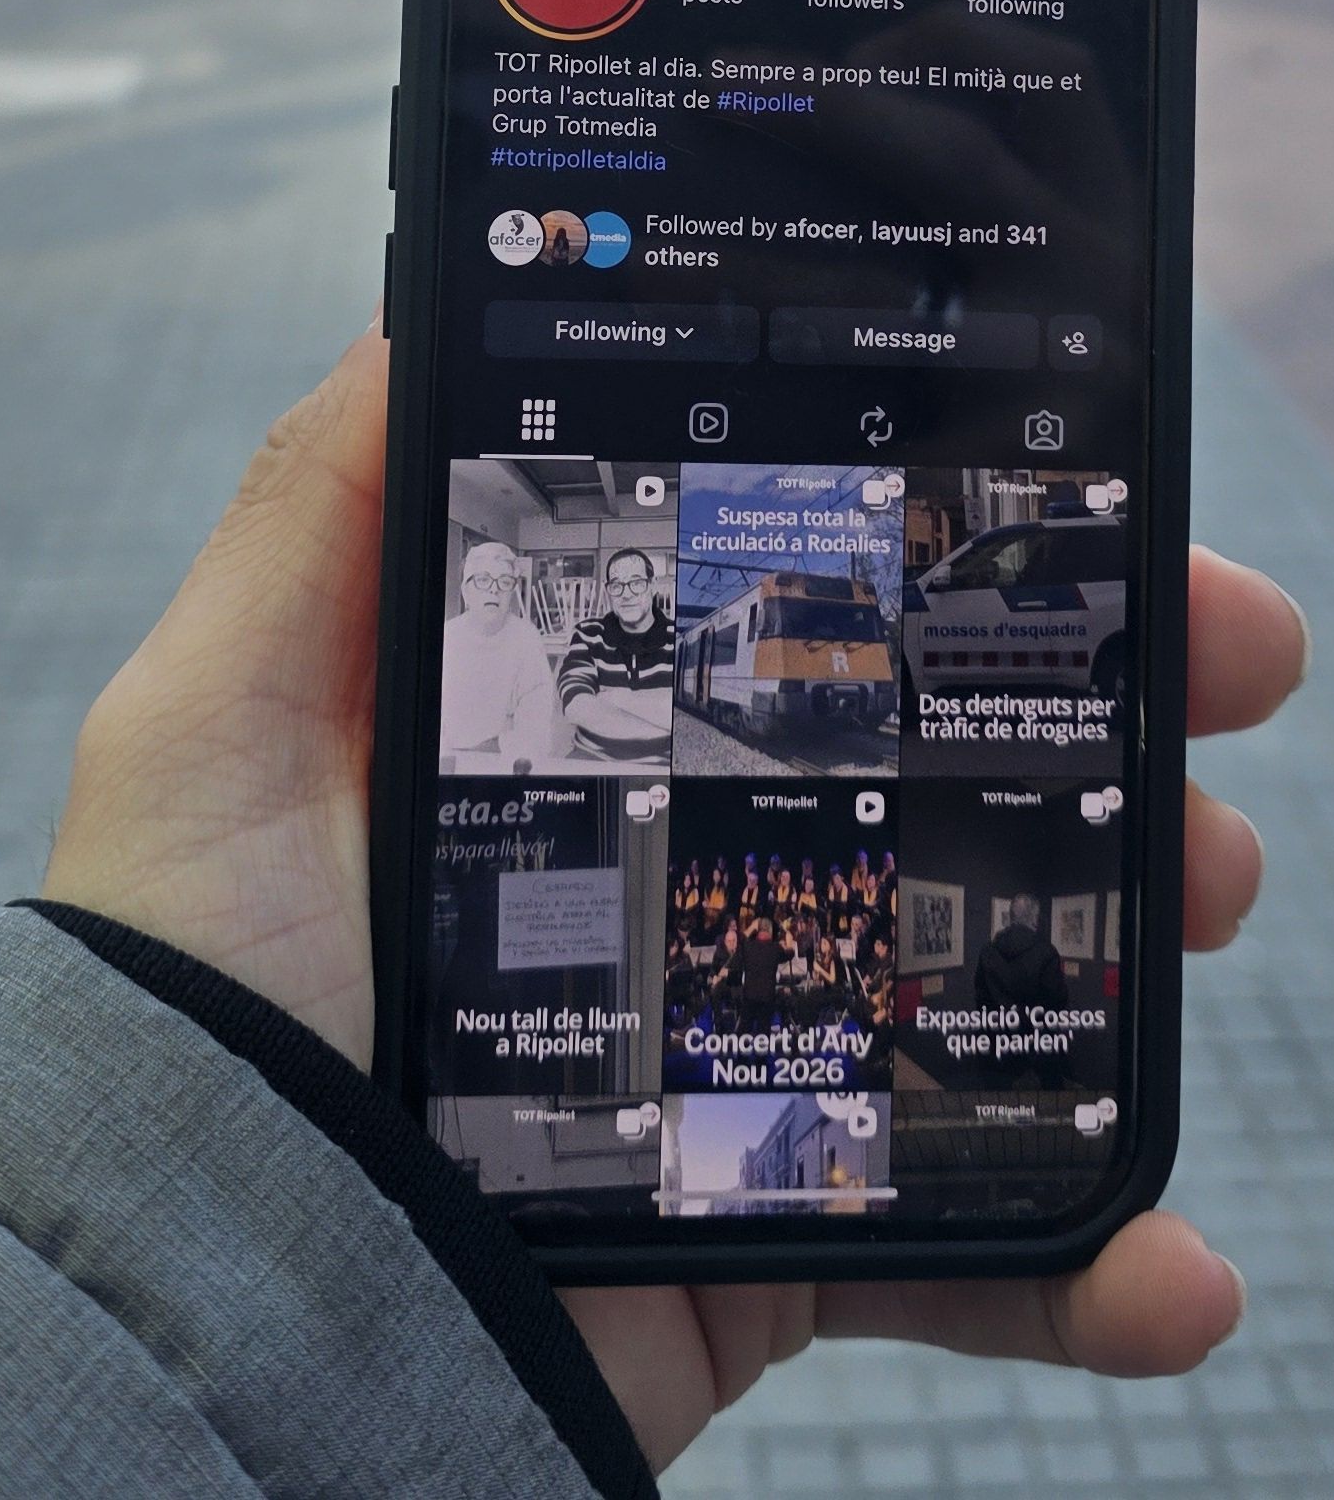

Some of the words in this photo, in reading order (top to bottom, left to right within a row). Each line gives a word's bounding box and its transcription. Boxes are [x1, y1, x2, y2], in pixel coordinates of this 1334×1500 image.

[495, 53, 541, 72] TOT
[549, 54, 631, 77] Ripollet
[639, 57, 656, 76] al
[664, 58, 702, 77] dia.
[711, 60, 795, 84] Sempre
[803, 67, 814, 81] a
[823, 68, 871, 87] prop
[879, 66, 919, 84] teu!
[929, 67, 946, 86] El
[955, 68, 1005, 91] mitjà
[1013, 75, 1053, 92] que
[1061, 73, 1081, 91] et
[494, 86, 554, 107] porta
[560, 85, 675, 108] l'actualitat
[683, 90, 710, 109] de
[717, 92, 814, 114] #Ripollet
[493, 114, 546, 137] Grup
[555, 116, 656, 137] Totmedia
[491, 148, 665, 171] #totripolletaldia
[489, 232, 542, 246] afocer
[647, 215, 743, 235] Followed
[752, 217, 777, 241] by
[785, 218, 862, 243] afocer,
[873, 221, 951, 246] layuusj
[959, 224, 998, 243] and
[1007, 225, 1046, 245] 341
[645, 246, 718, 266] others
[556, 320, 665, 346] Following
[855, 328, 955, 353] Message
[776, 477, 798, 488] TOT
[798, 478, 836, 491] Ripollet
[987, 482, 1009, 494] TOT
[1009, 483, 1047, 495] Ripollet
[717, 507, 798, 530] Suspesa
[802, 510, 844, 527] tota
[848, 508, 867, 528] la
[691, 532, 787, 552] circulació
[790, 538, 803, 552] a
[808, 534, 891, 554] Rodalies
[924, 623, 988, 638] mossos
[994, 621, 1087, 640] d'esquadra
[919, 693, 961, 715] Dos
[966, 693, 1073, 720] detinguts
[1077, 698, 1117, 721] per
[920, 717, 980, 740] tràfic
[984, 717, 1013, 740] de
[1017, 717, 1108, 746] drogues
[523, 791, 546, 802] TOT
[547, 790, 586, 804] Ripollet
[751, 796, 777, 808] TOT
[777, 796, 818, 810] Ripollet
[982, 792, 1005, 804] TOT
[1005, 792, 1042, 805] Ripollet
[455, 1008, 506, 1034] Nou
[510, 1008, 549, 1034] tall
[553, 1008, 582, 1032] de
[587, 1007, 641, 1032] llum
[915, 1005, 1020, 1035] Exposició
[1025, 1006, 1106, 1031] 'Cossos
[495, 1036, 511, 1057] a
[515, 1031, 605, 1061] Ripollet
[684, 1029, 792, 1056] Concert
[797, 1028, 874, 1060] d'Any
[946, 1032, 991, 1059] que
[995, 1030, 1074, 1059] parlen'
[712, 1059, 769, 1085] Nou
[773, 1058, 845, 1084] 2026
[513, 1110, 536, 1121] TOT
[536, 1110, 576, 1124] Ripollet
[975, 1105, 997, 1116] TOT
